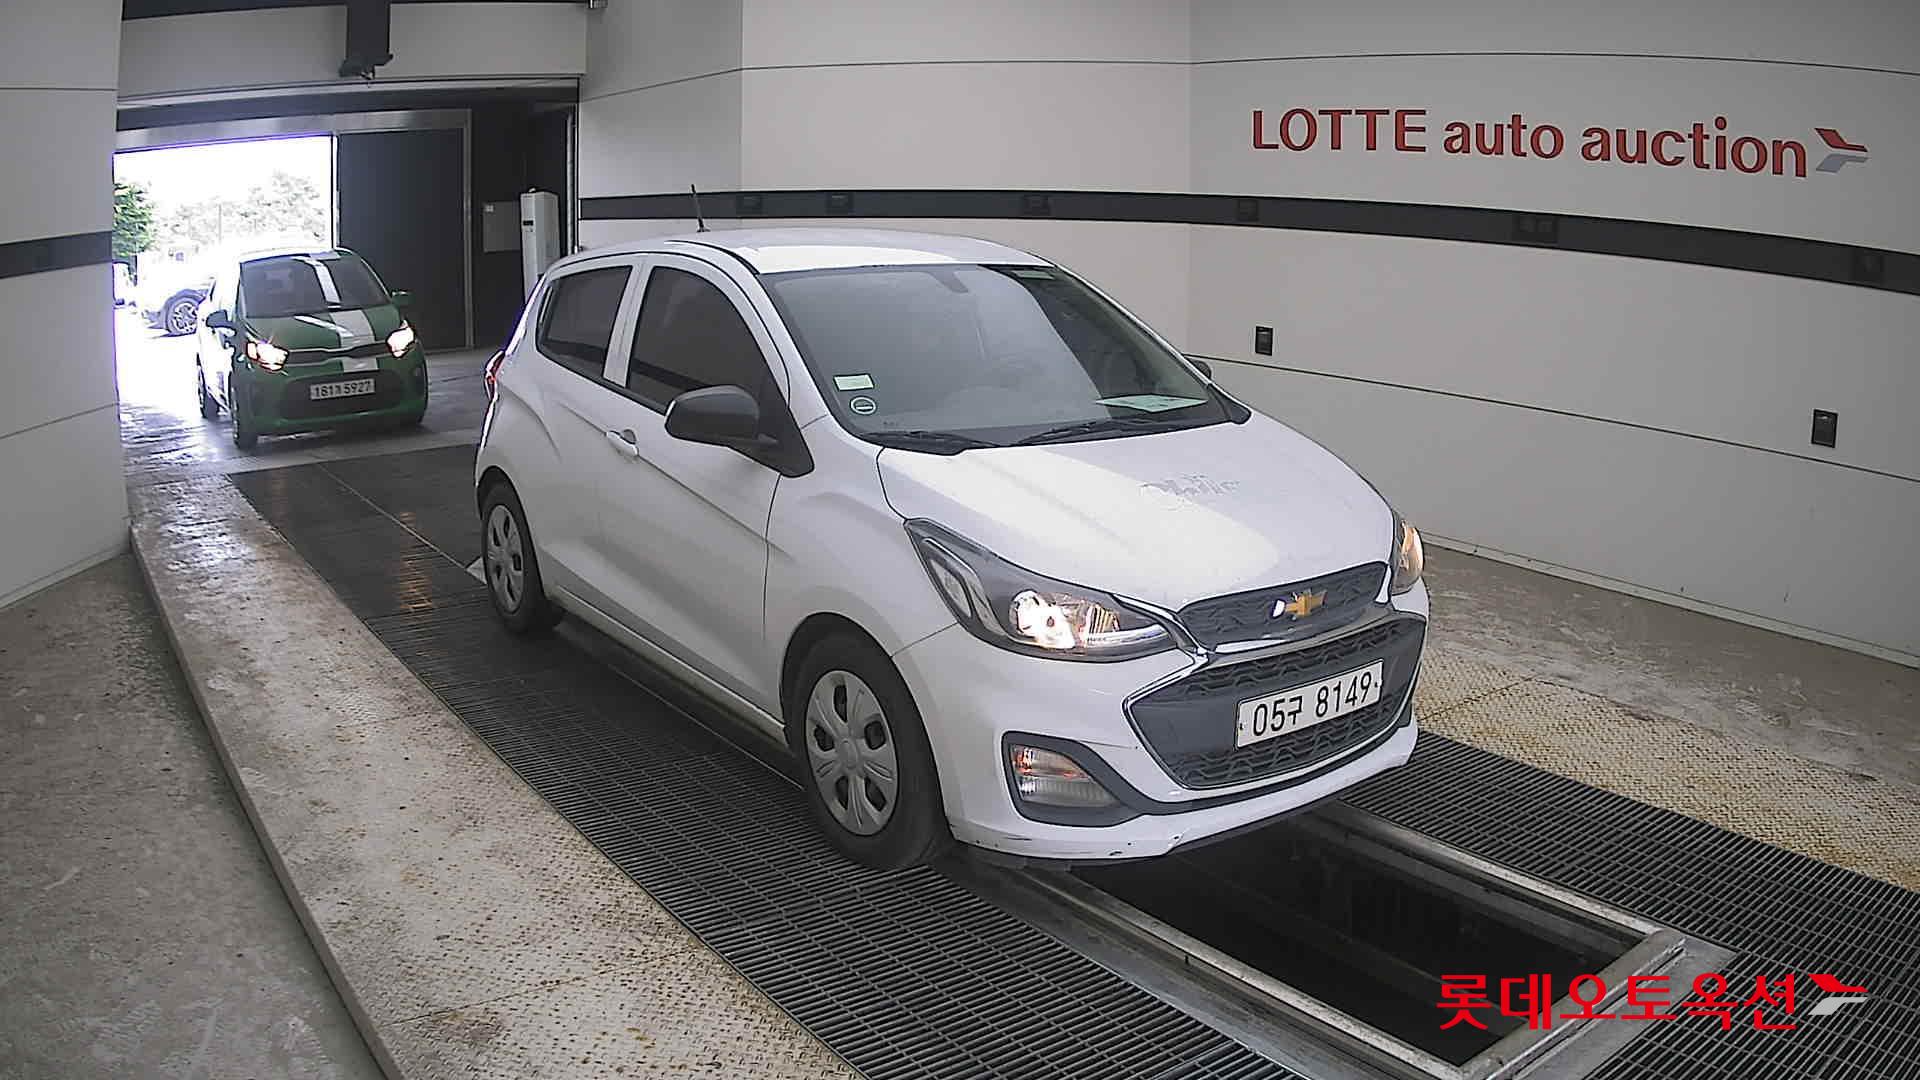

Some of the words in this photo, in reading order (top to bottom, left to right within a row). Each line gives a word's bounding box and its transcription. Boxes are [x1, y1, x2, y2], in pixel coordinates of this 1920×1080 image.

[1252, 108, 1427, 153] LOTTE
[1443, 113, 1566, 158] auto
[1581, 115, 1808, 178] auction
[1253, 695, 1303, 737] 05구
[1315, 671, 1373, 718] 8149
